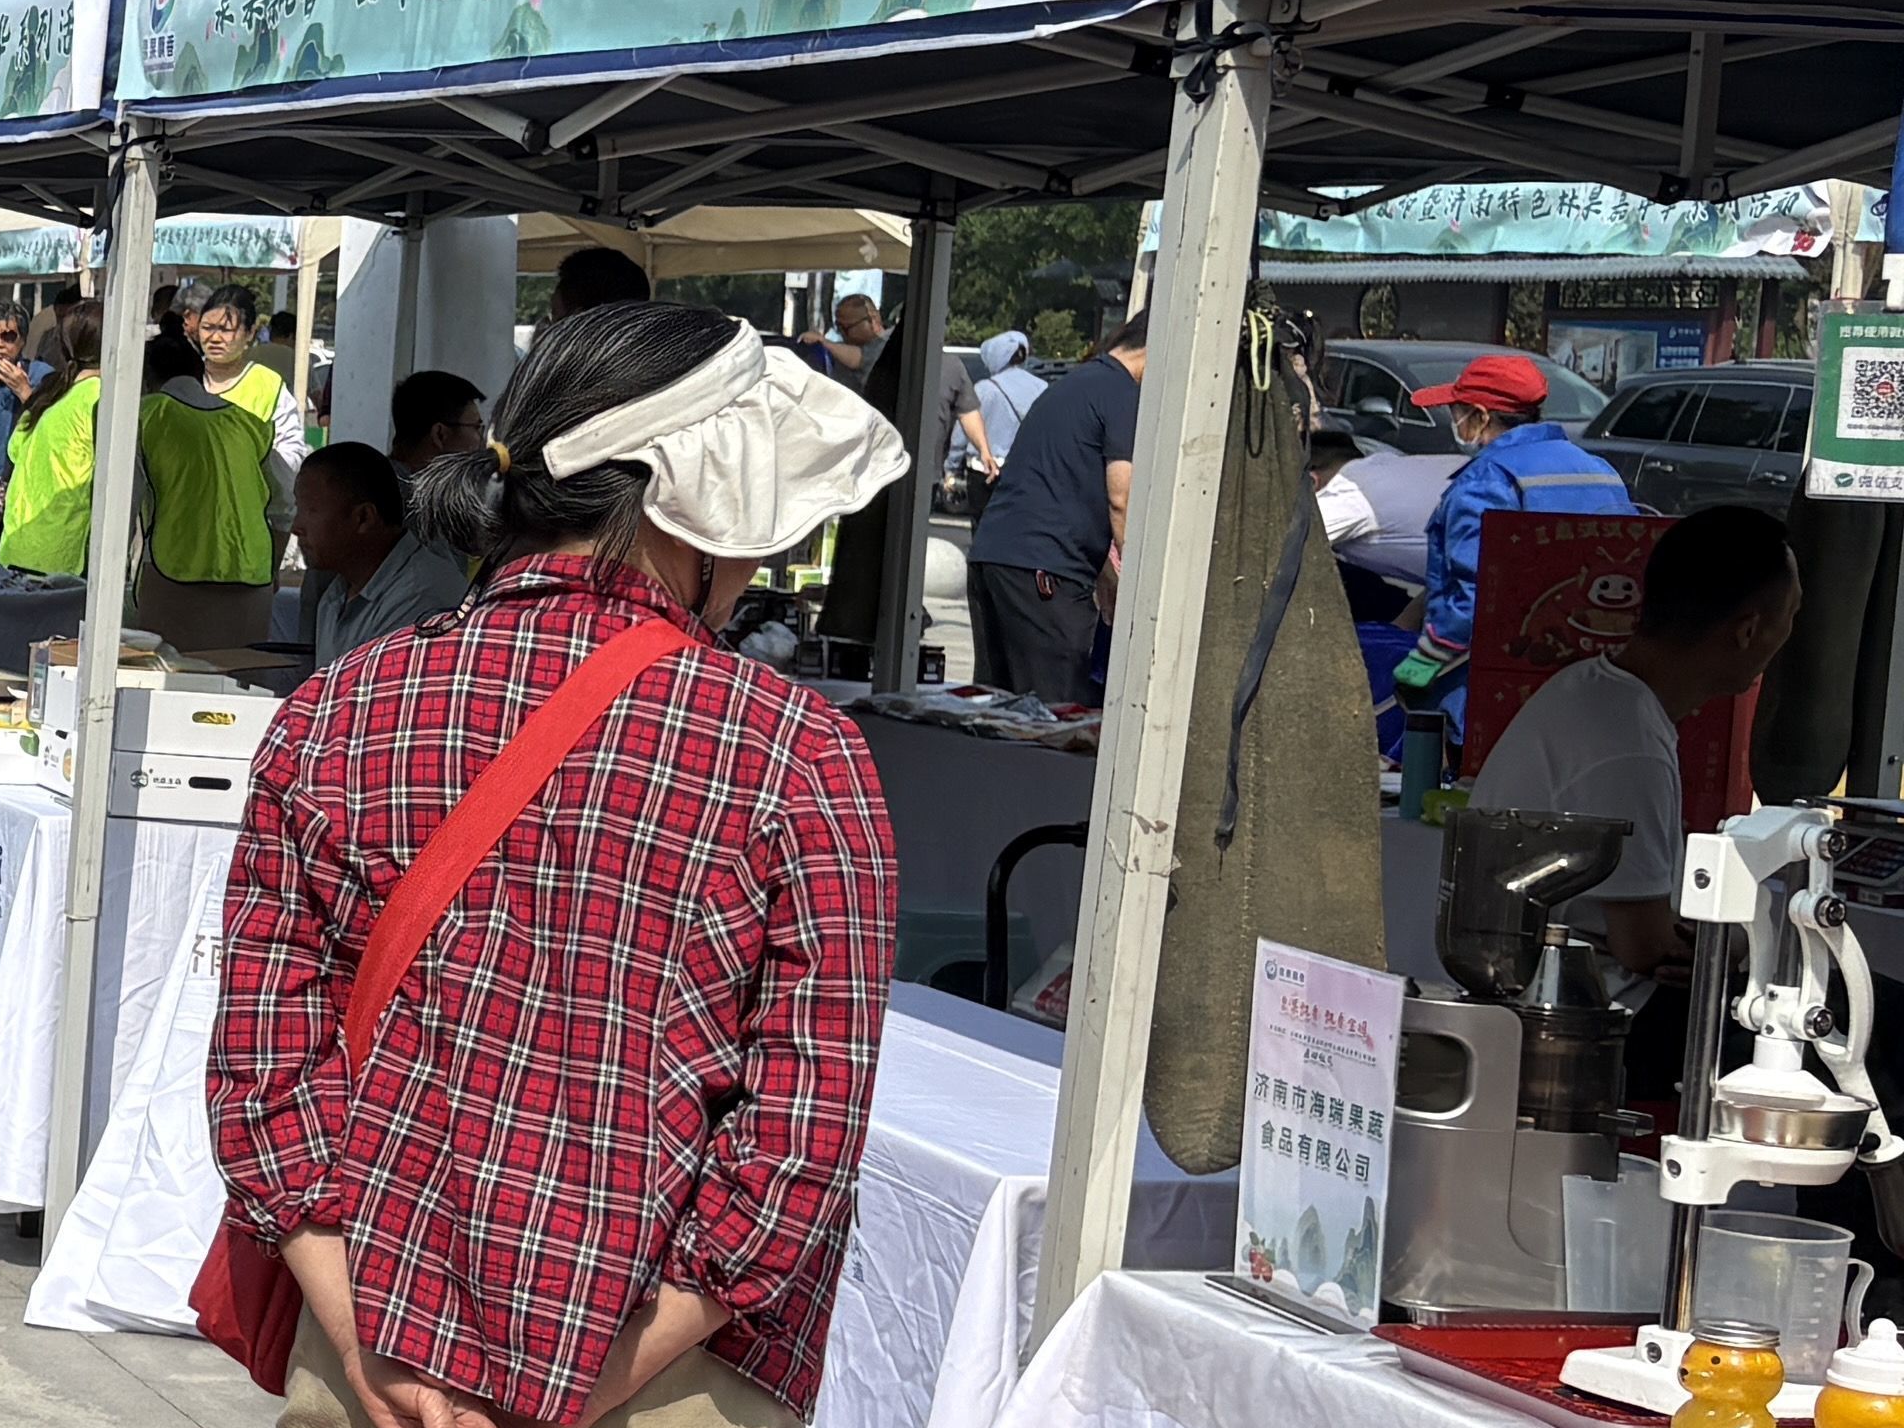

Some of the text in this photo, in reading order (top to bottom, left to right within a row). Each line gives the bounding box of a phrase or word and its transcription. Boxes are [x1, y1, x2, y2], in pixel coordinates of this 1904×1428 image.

[1253, 1071, 1385, 1139] 济南市海瑞果蔬
[1260, 1119, 1371, 1182] 食品有限公司
